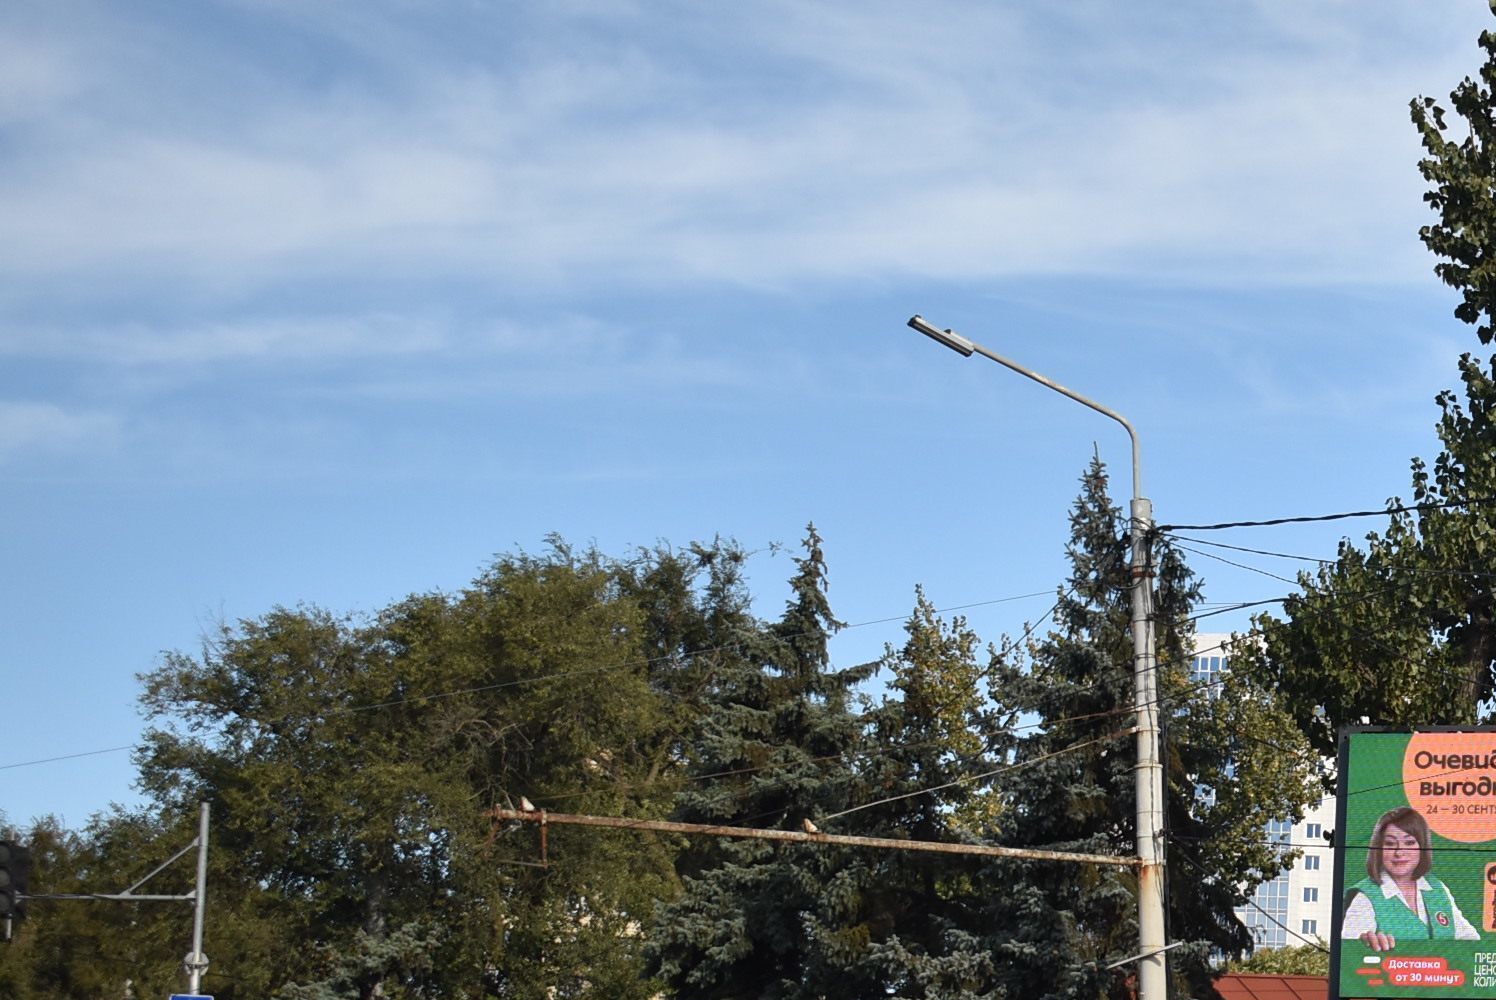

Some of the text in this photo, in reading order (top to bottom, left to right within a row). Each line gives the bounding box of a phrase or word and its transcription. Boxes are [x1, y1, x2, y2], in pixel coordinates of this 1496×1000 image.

[1426, 804, 1438, 815] 24
[1452, 804, 1464, 815] 30
[1388, 960, 1441, 969] Доставка
[1395, 973, 1460, 984] от 30 минут
